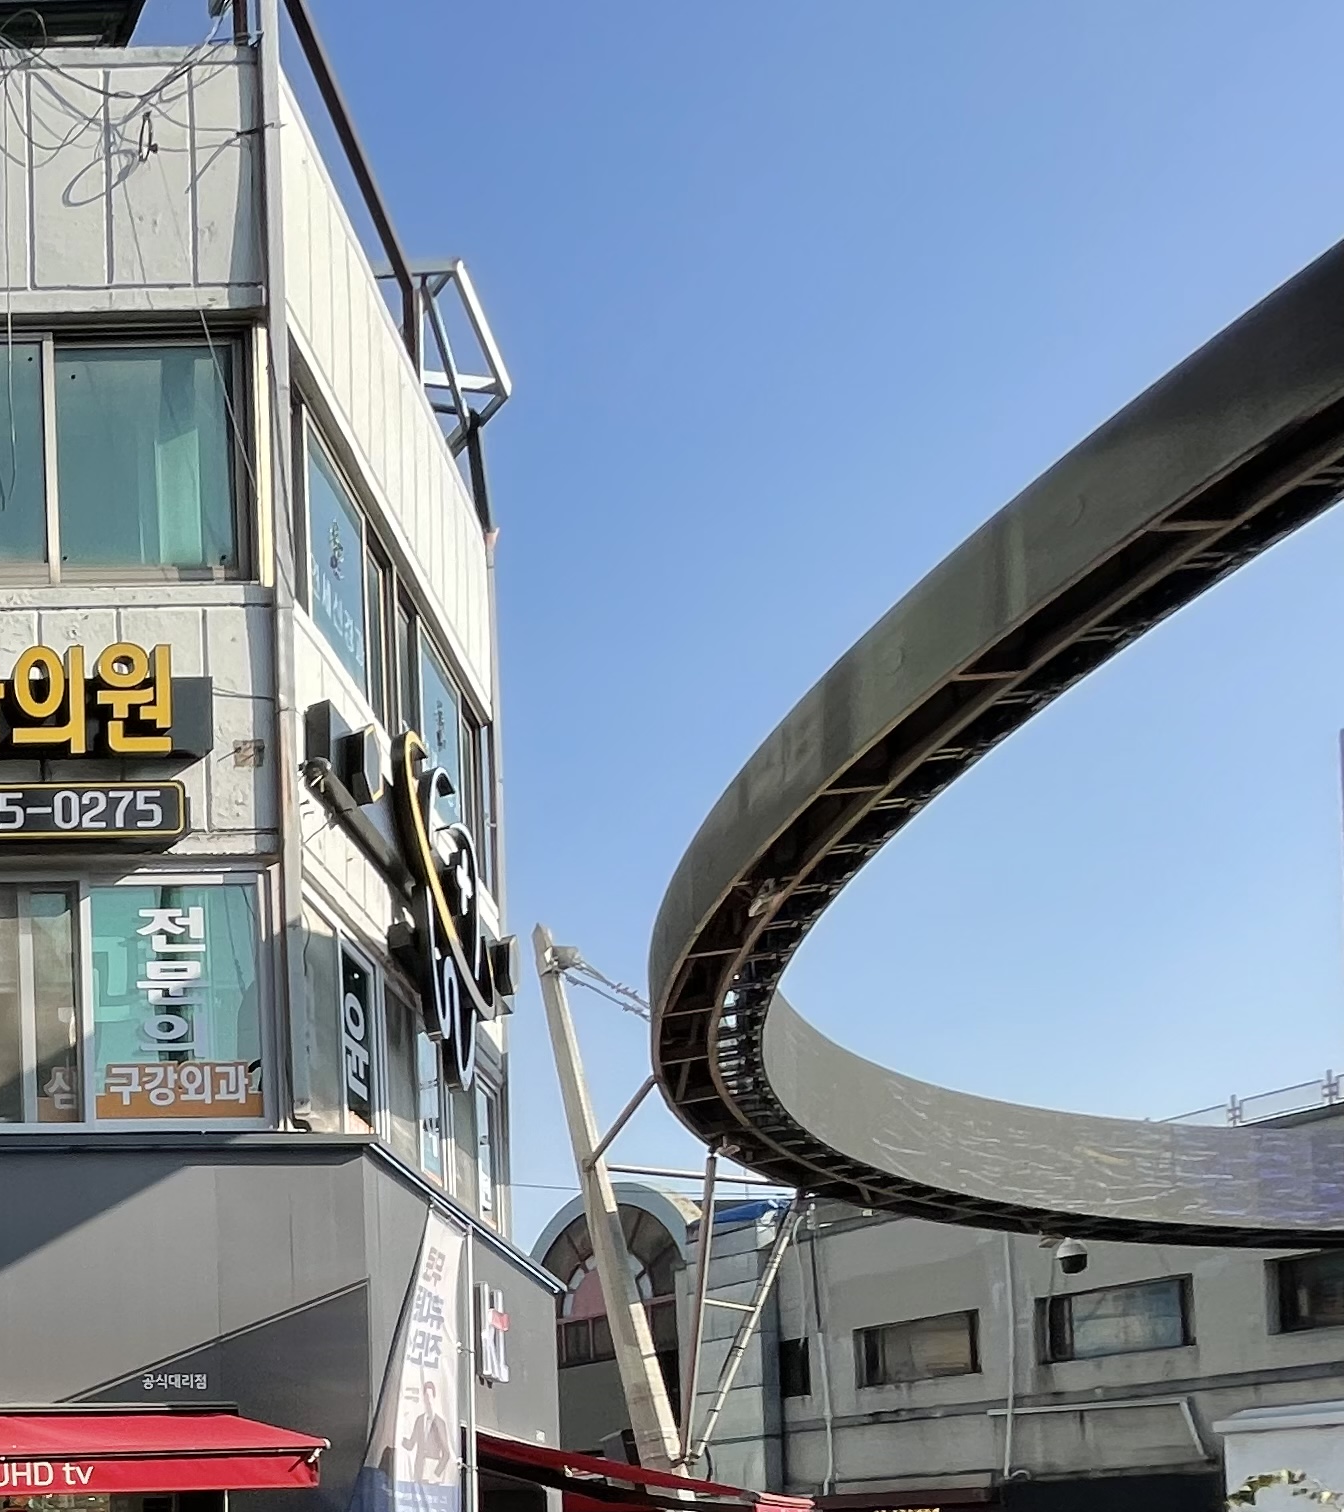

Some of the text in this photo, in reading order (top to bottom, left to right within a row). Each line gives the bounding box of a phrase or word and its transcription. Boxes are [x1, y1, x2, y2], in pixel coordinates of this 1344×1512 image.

[136, 906, 207, 1059] 전문의
[109, 1064, 249, 1106] 구강외과
[480, 1282, 510, 1383] kt
[142, 1374, 207, 1390] 공식대리점
[61, 1461, 94, 1487] tv
